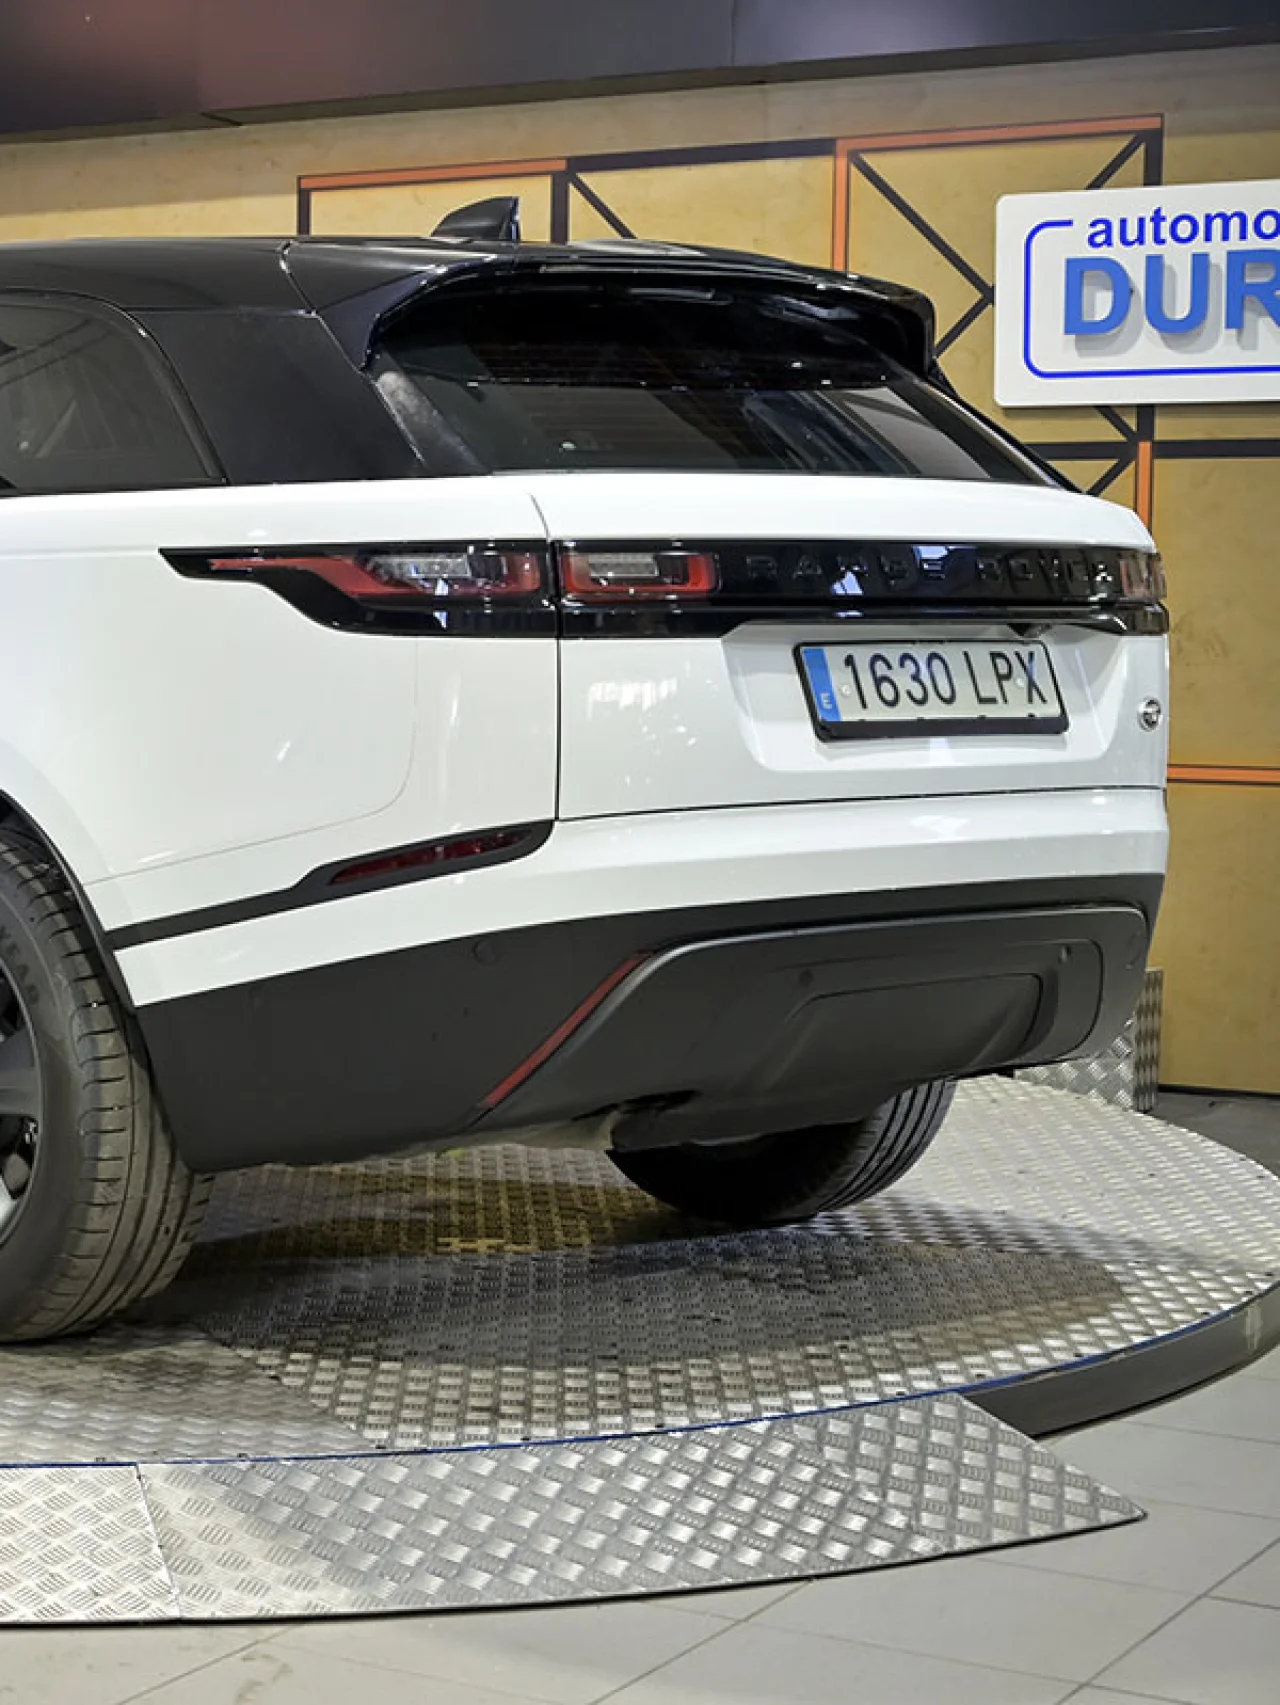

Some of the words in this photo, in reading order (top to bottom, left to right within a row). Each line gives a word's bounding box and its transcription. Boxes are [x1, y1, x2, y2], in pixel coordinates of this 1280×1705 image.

[1087, 206, 1280, 248] automo
[1064, 248, 1280, 335] DUR
[844, 651, 957, 709] 1630
[963, 650, 1048, 705] LPX
